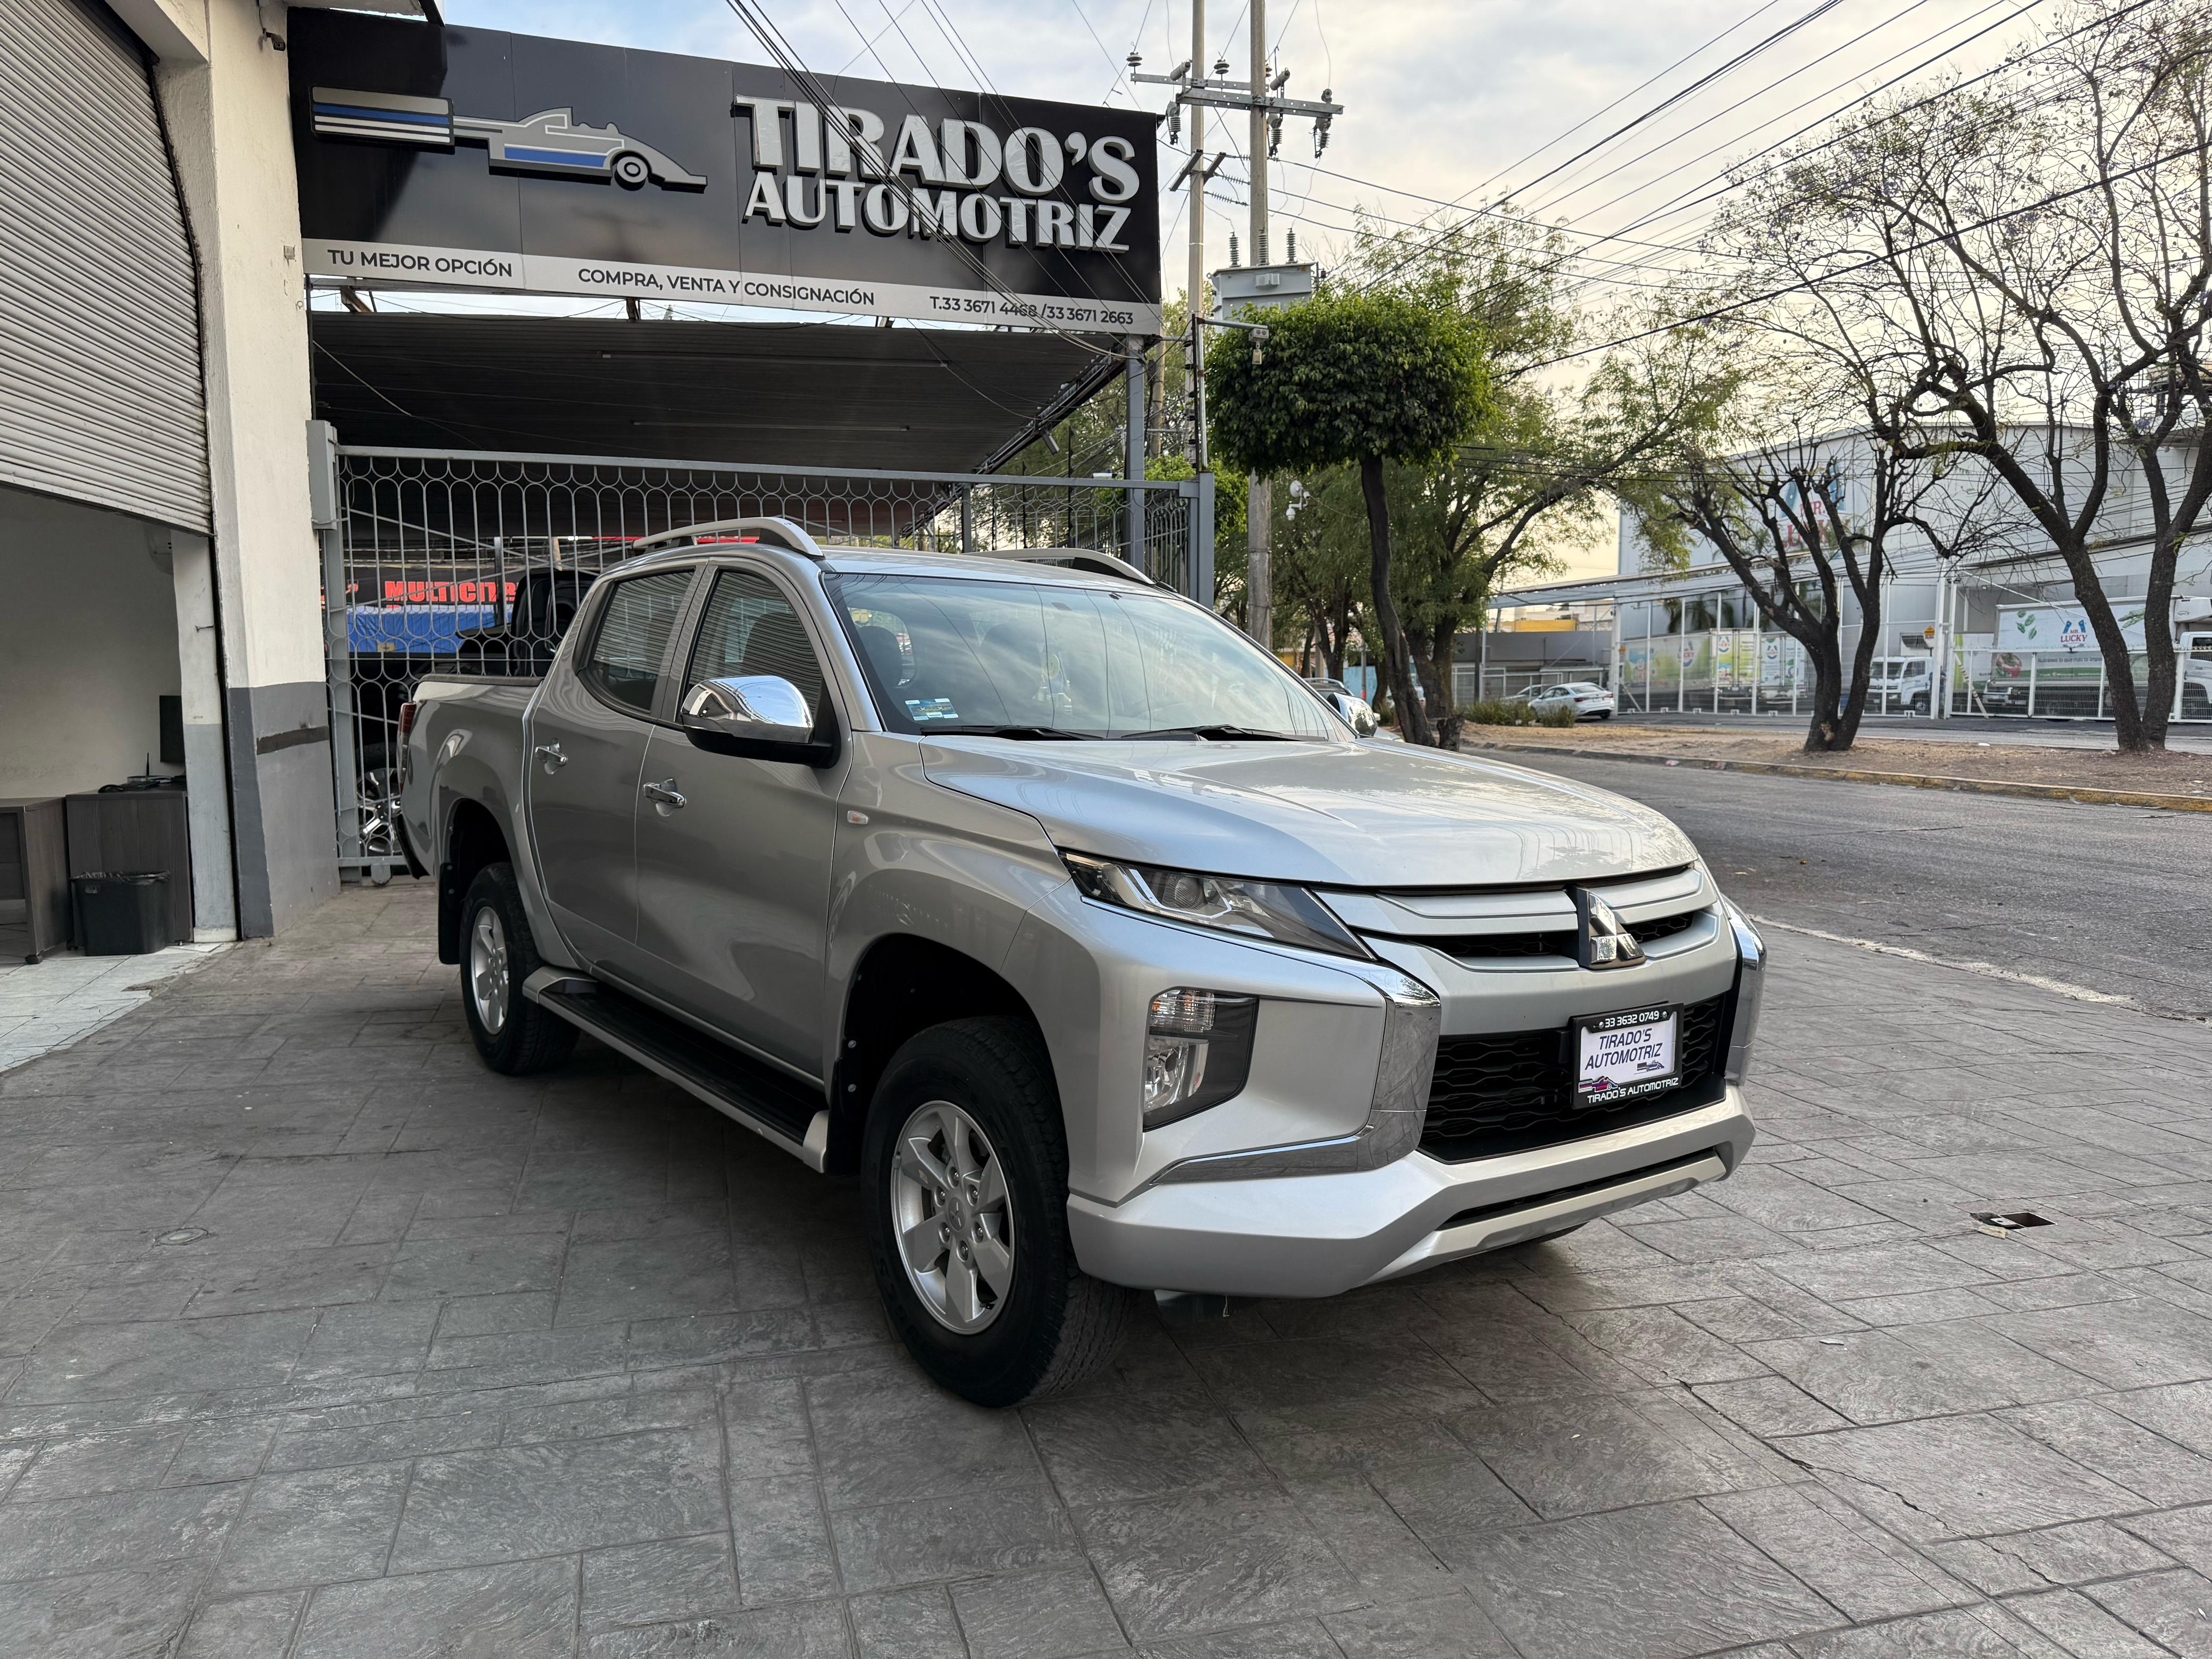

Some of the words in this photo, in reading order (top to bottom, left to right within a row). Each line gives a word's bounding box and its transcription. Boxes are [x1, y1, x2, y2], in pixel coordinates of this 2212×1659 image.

[733, 95, 1139, 204] TIRADO'S
[743, 171, 1132, 254] AUTOMOTRIZ
[327, 249, 354, 265] TU
[361, 252, 430, 271] MEJOR
[435, 258, 512, 278] OPCIÓN
[578, 269, 663, 290] COMPRA,
[667, 275, 726, 293] VENTA
[728, 280, 741, 294] Y
[744, 282, 874, 306] CONSIGNACIÓN
[964, 299, 995, 314] 3671
[1067, 308, 1097, 322] 3671
[1100, 311, 1133, 325] 2663
[1605, 1019, 1615, 1027] 33
[1616, 1015, 1638, 1026] 3632
[1639, 1011, 1659, 1022] 0749
[1599, 1028, 1653, 1050] TIRADO'S
[1585, 1042, 1663, 1070] AUTOMOTRIZ
[1587, 1087, 1626, 1103] TIRADO'S
[1628, 1077, 1678, 1095] AUTOMOTRIZ
